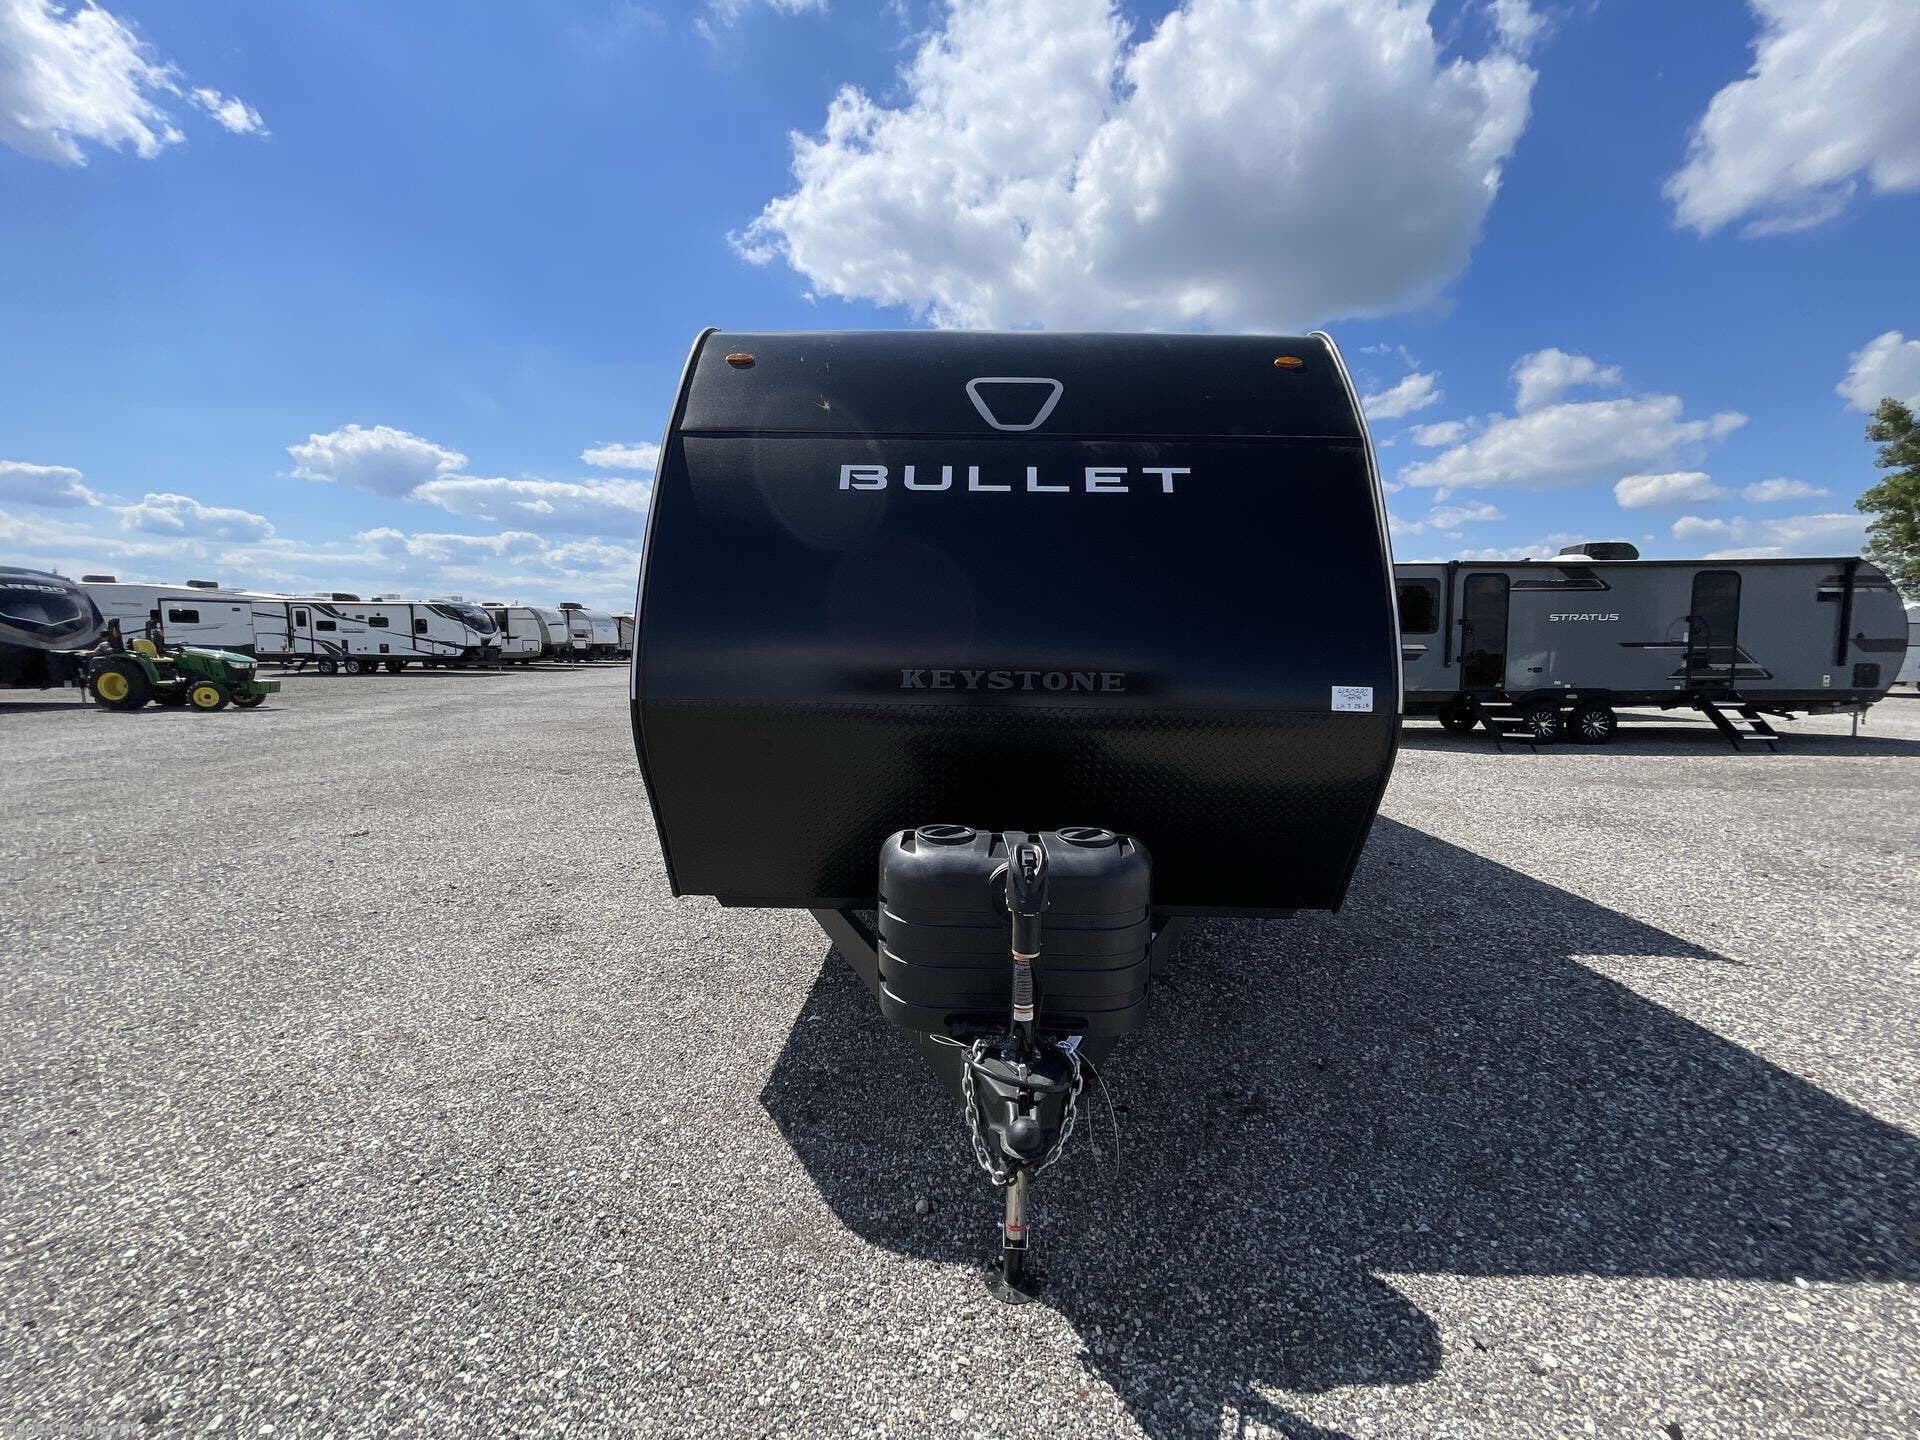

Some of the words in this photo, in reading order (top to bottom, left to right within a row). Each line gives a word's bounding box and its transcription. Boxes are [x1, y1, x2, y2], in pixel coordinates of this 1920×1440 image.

[839, 464, 1191, 493] BULLET
[1549, 613, 1619, 622] STRATUS
[900, 669, 1126, 693] KEYSTONE
